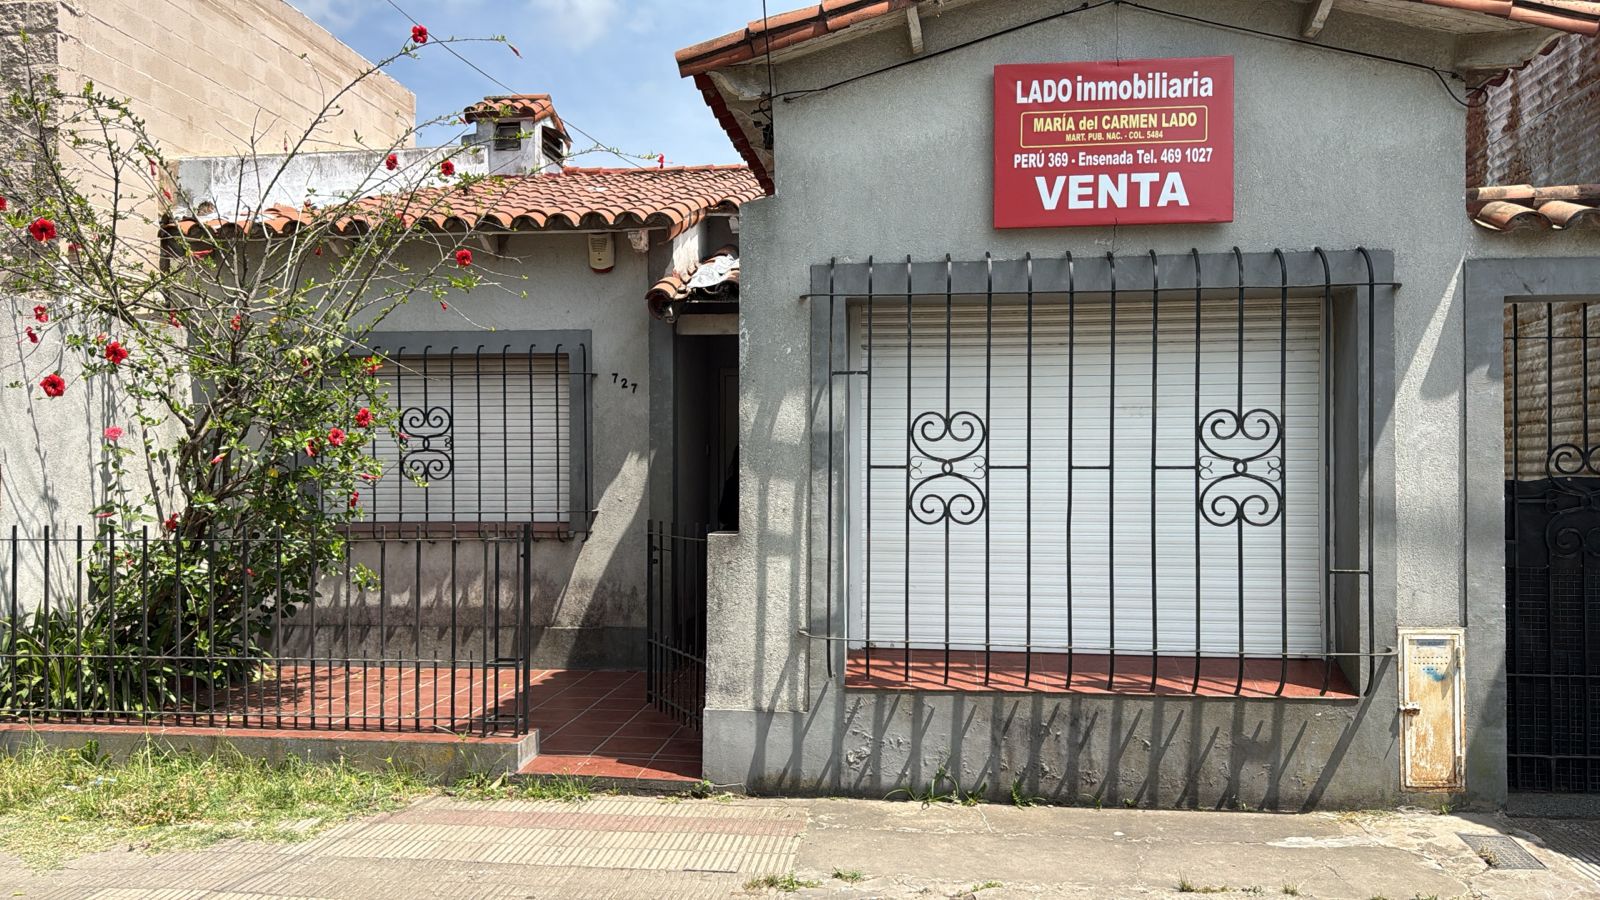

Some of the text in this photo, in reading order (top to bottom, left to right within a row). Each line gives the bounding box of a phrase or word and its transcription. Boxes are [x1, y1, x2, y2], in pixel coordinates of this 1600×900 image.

[1016, 71, 1213, 104] LADO inmobiliaria
[1033, 112, 1197, 133] MARÍA del CARMEN LADO
[1065, 133, 1086, 142] MART.
[1088, 132, 1104, 141] PUB.
[1106, 131, 1123, 140] NAC.
[1128, 131, 1145, 139] COL.
[1146, 130, 1163, 139] 5484
[1013, 149, 1045, 169] PERÚ
[1047, 152, 1069, 168] 369
[1078, 150, 1133, 167] Ensenada
[1136, 149, 1158, 164] Tel.
[1160, 148, 1182, 164] 469
[1185, 147, 1213, 163] 1027
[1034, 171, 1190, 211] VENTA
[611, 372, 638, 394] 727
